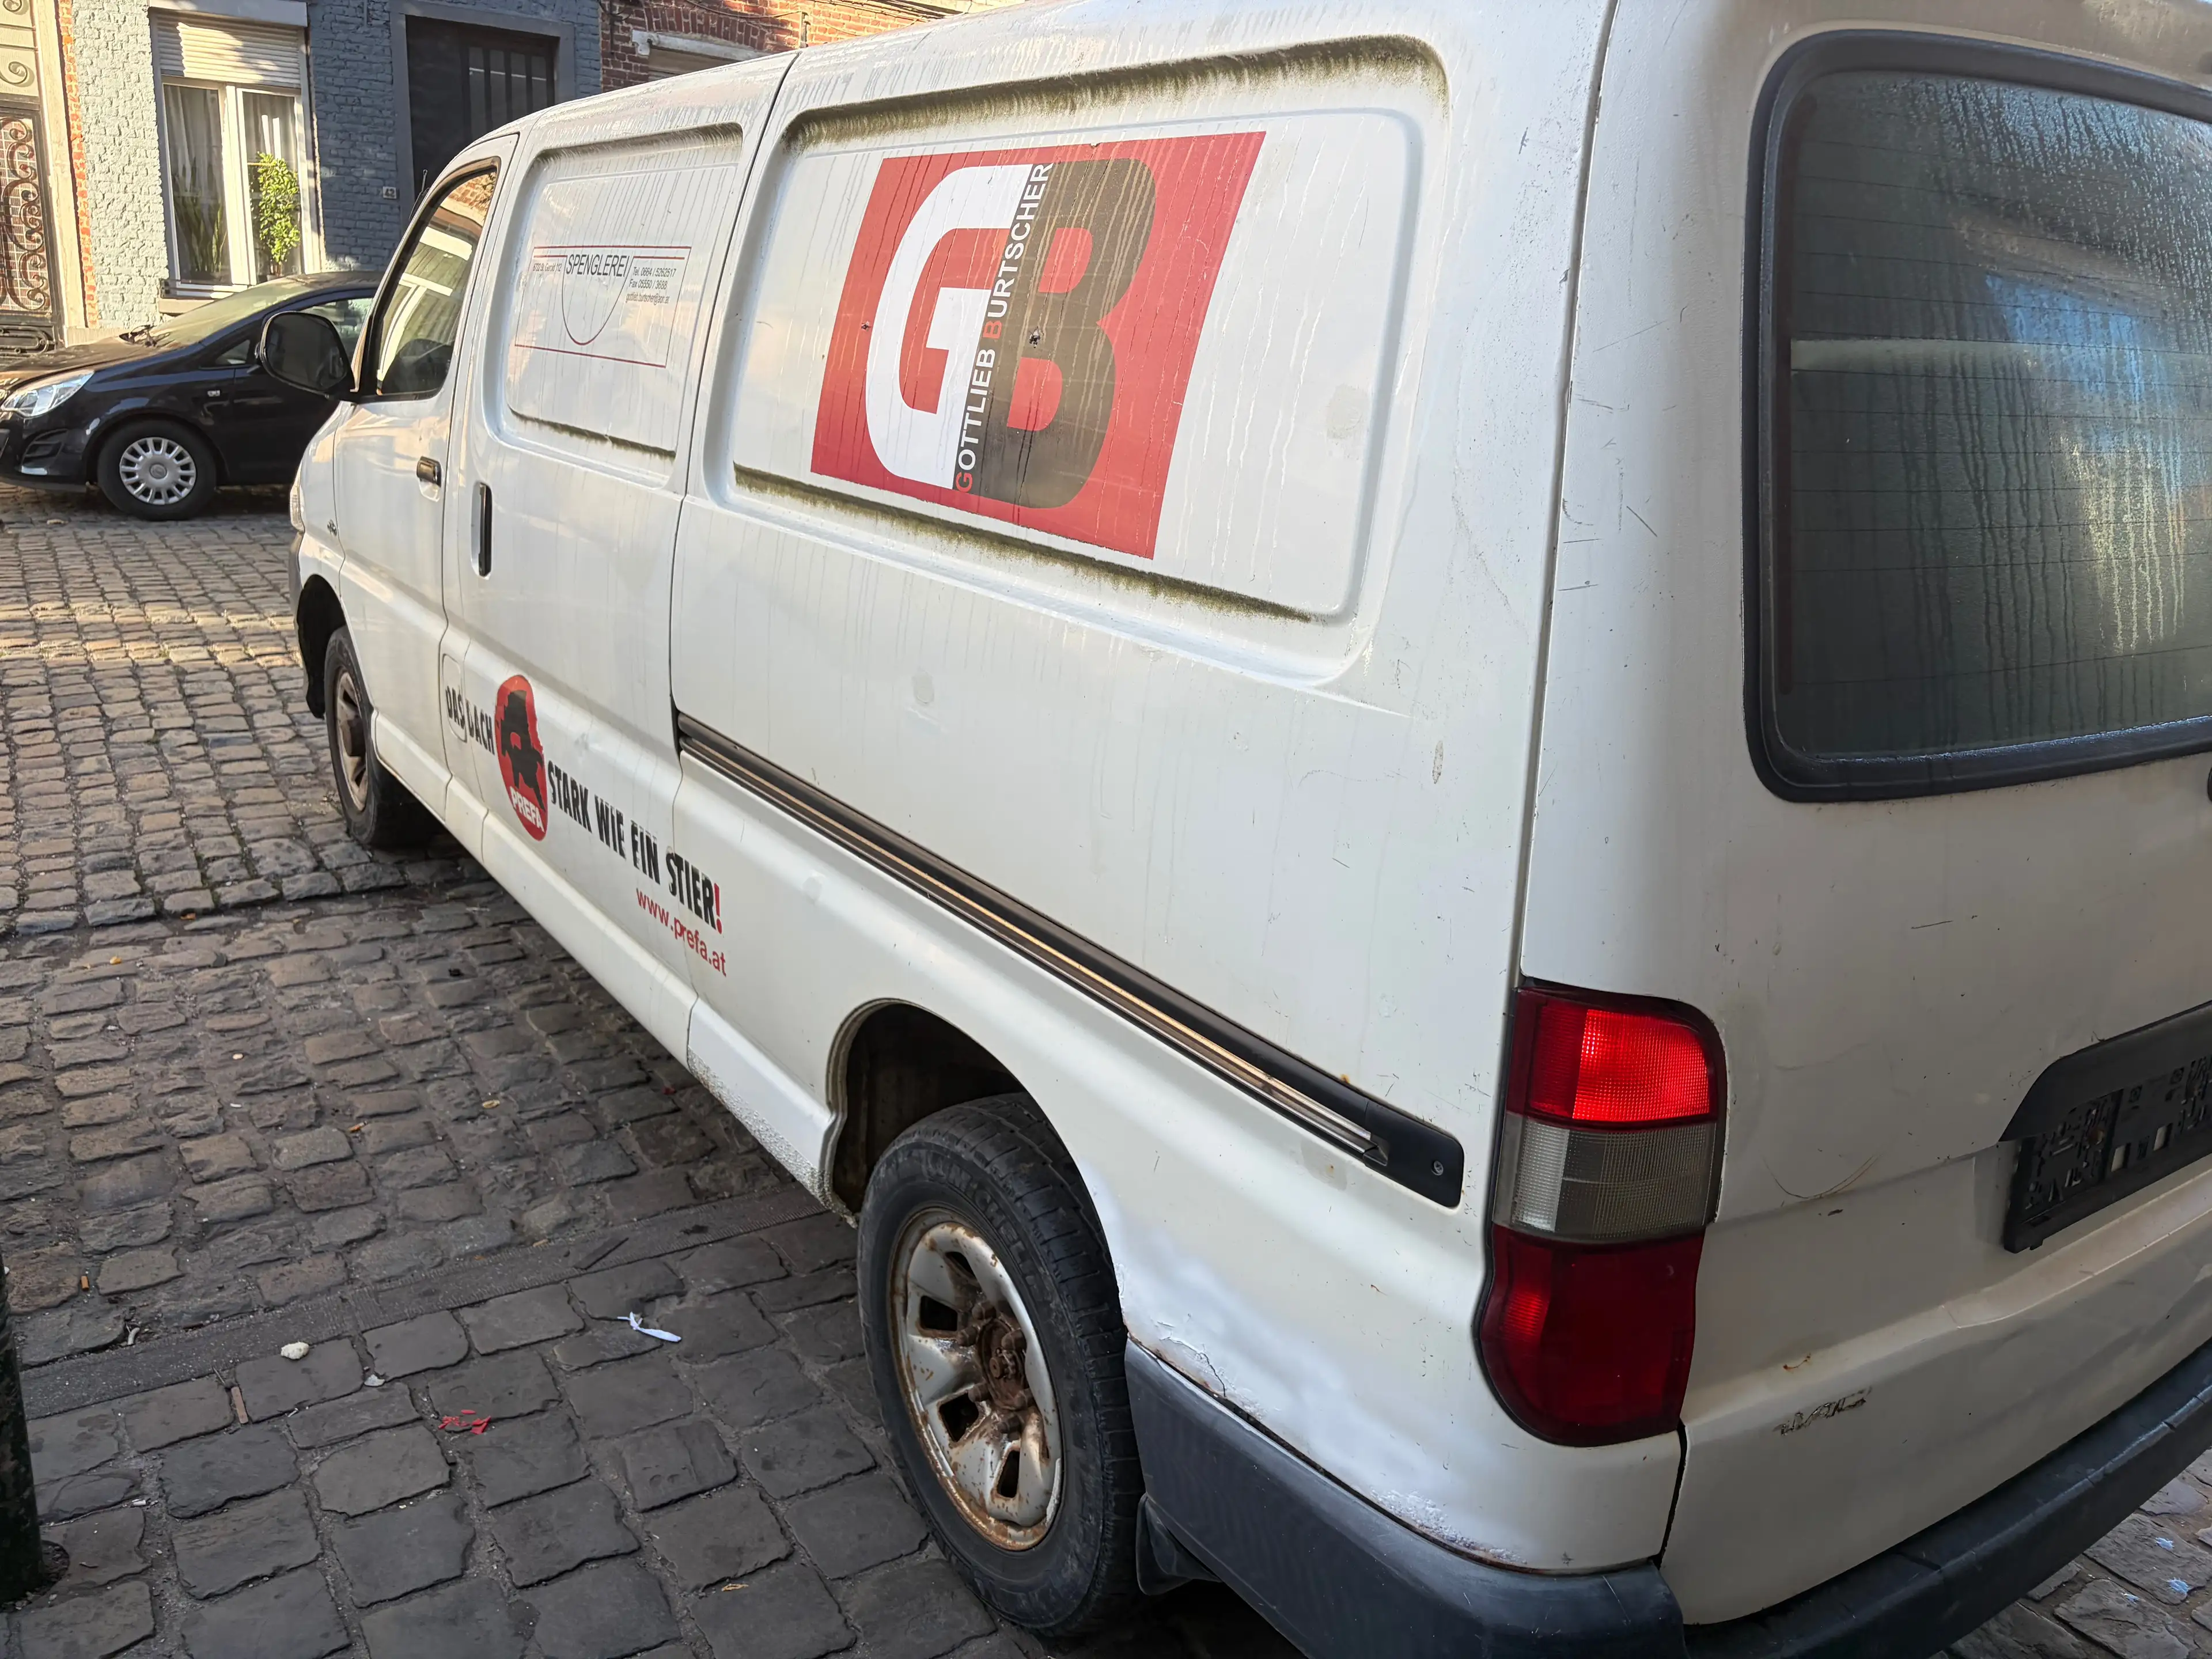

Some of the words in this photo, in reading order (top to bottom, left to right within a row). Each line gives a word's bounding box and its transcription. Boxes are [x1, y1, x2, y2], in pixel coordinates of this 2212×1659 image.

[566, 254, 630, 277] SPENGLEREI
[629, 279, 638, 287] Fax
[956, 349, 995, 492] GOTTLIEB
[983, 162, 1054, 339] BURTSCHER
[445, 685, 465, 730] DAS
[510, 786, 545, 833] PREFA
[548, 760, 593, 834] STARK
[594, 794, 627, 859] WIE
[630, 819, 661, 885] EIN
[666, 849, 723, 934] STIER!
[635, 888, 726, 978] www.prefa.at
